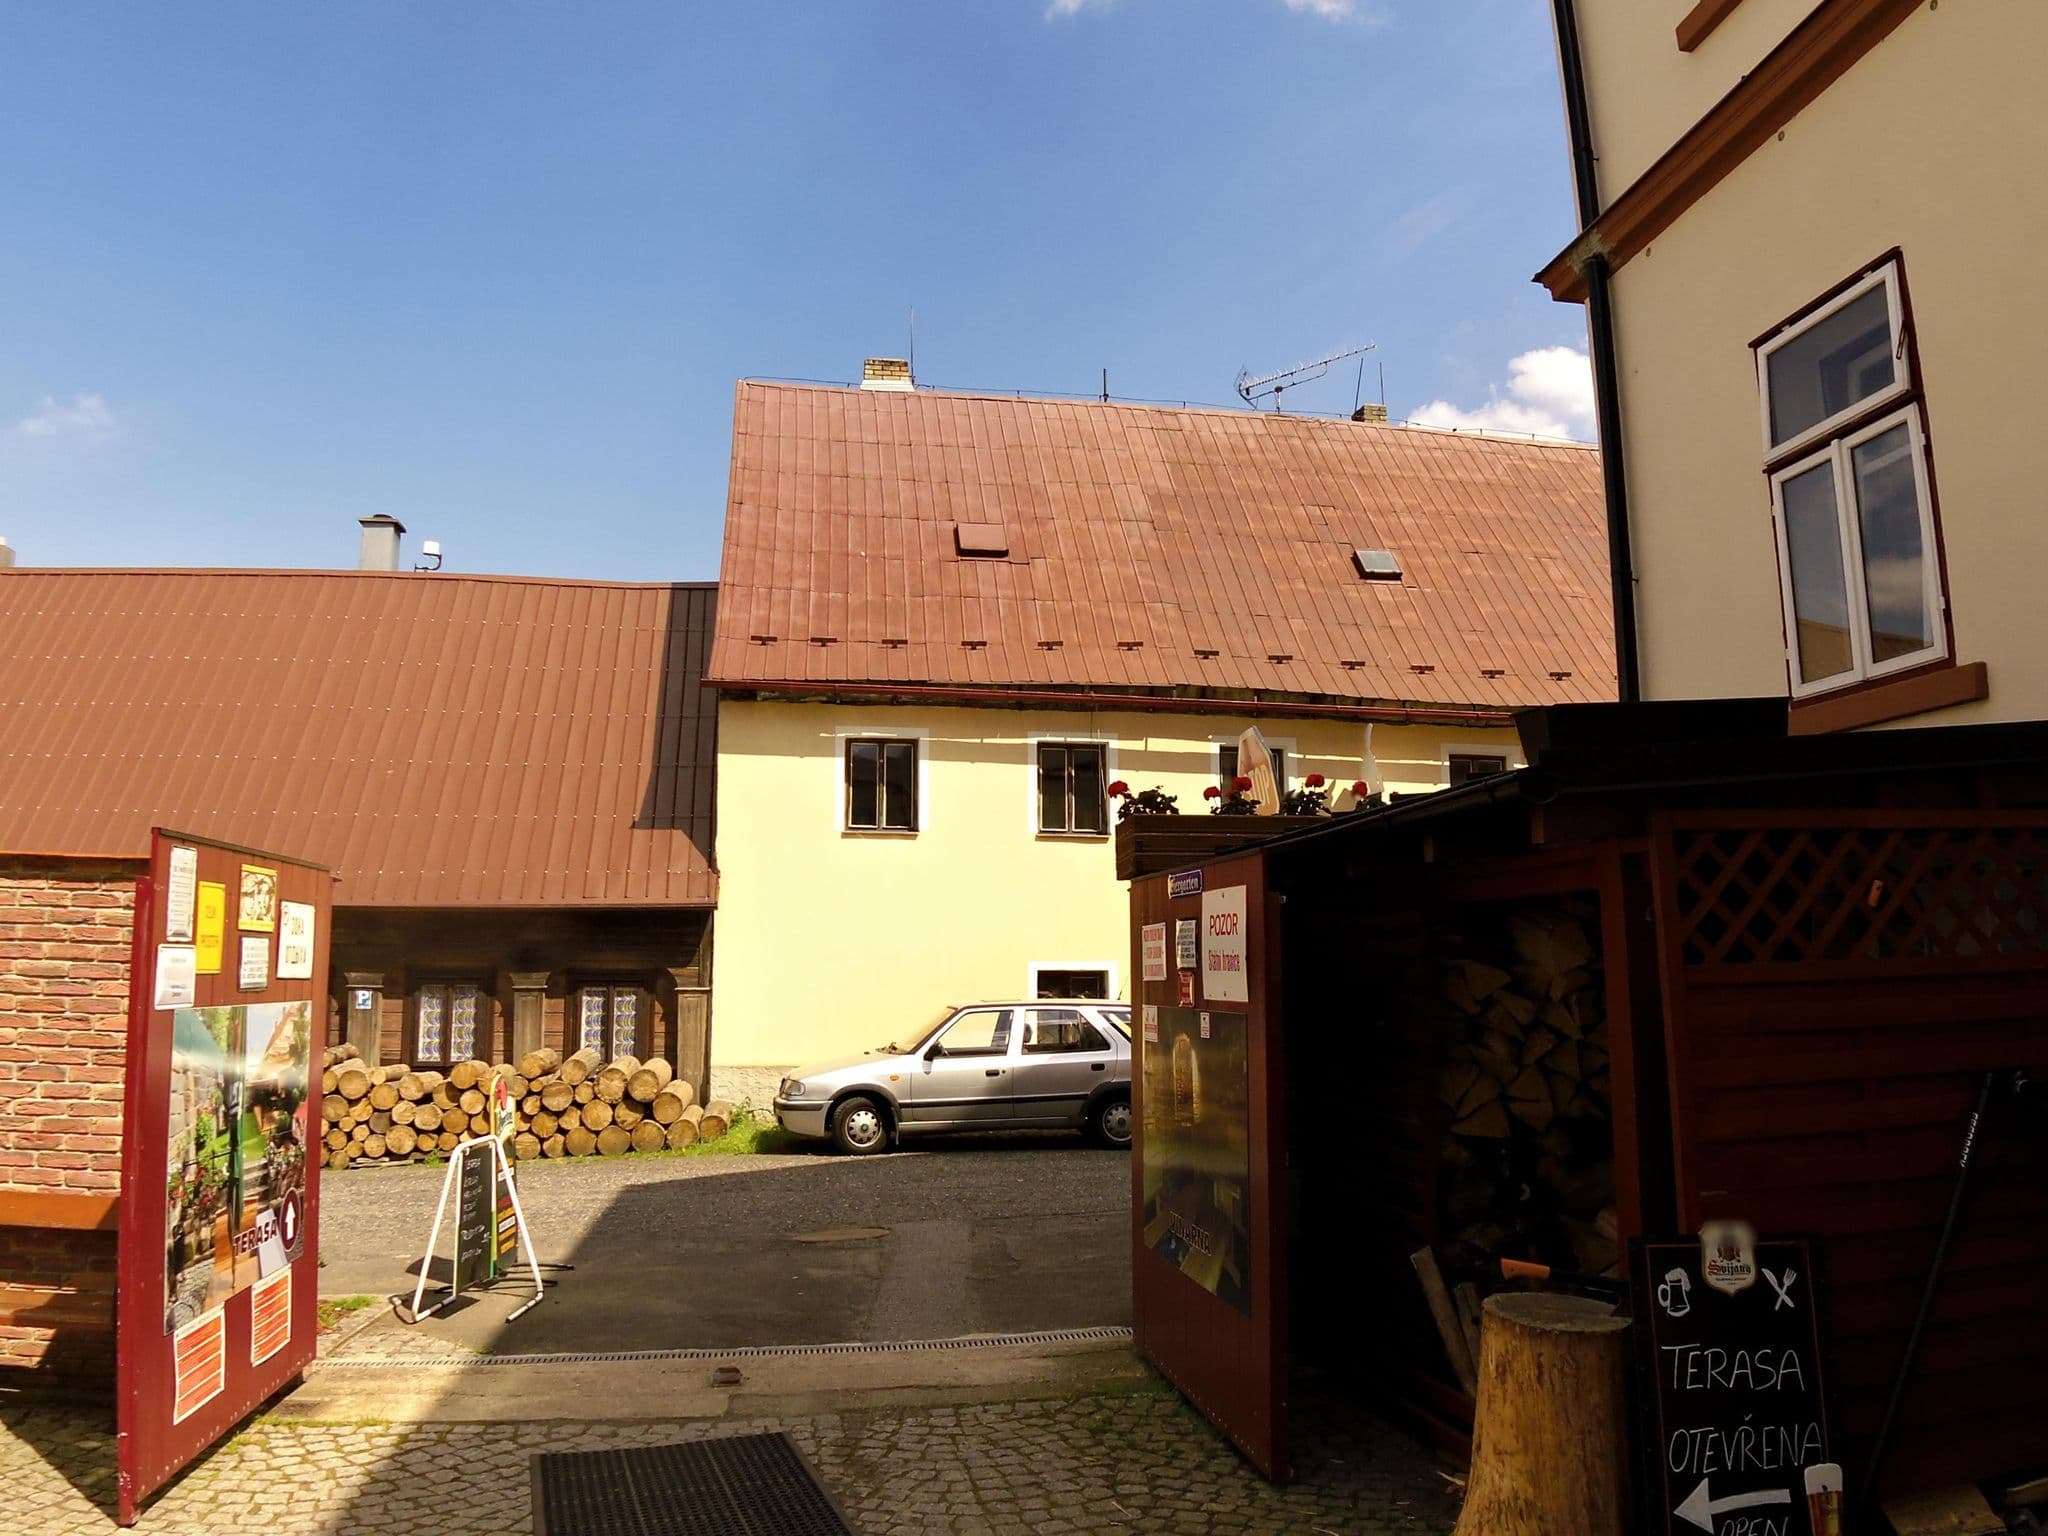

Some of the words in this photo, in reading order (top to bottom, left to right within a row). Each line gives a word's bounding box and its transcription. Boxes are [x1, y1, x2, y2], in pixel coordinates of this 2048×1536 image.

[1209, 913, 1239, 937] POZOR
[231, 1217, 279, 1257] TERASA
[1660, 1342, 1806, 1392] TERASA
[1667, 1412, 1825, 1475] OTEVŘENA
